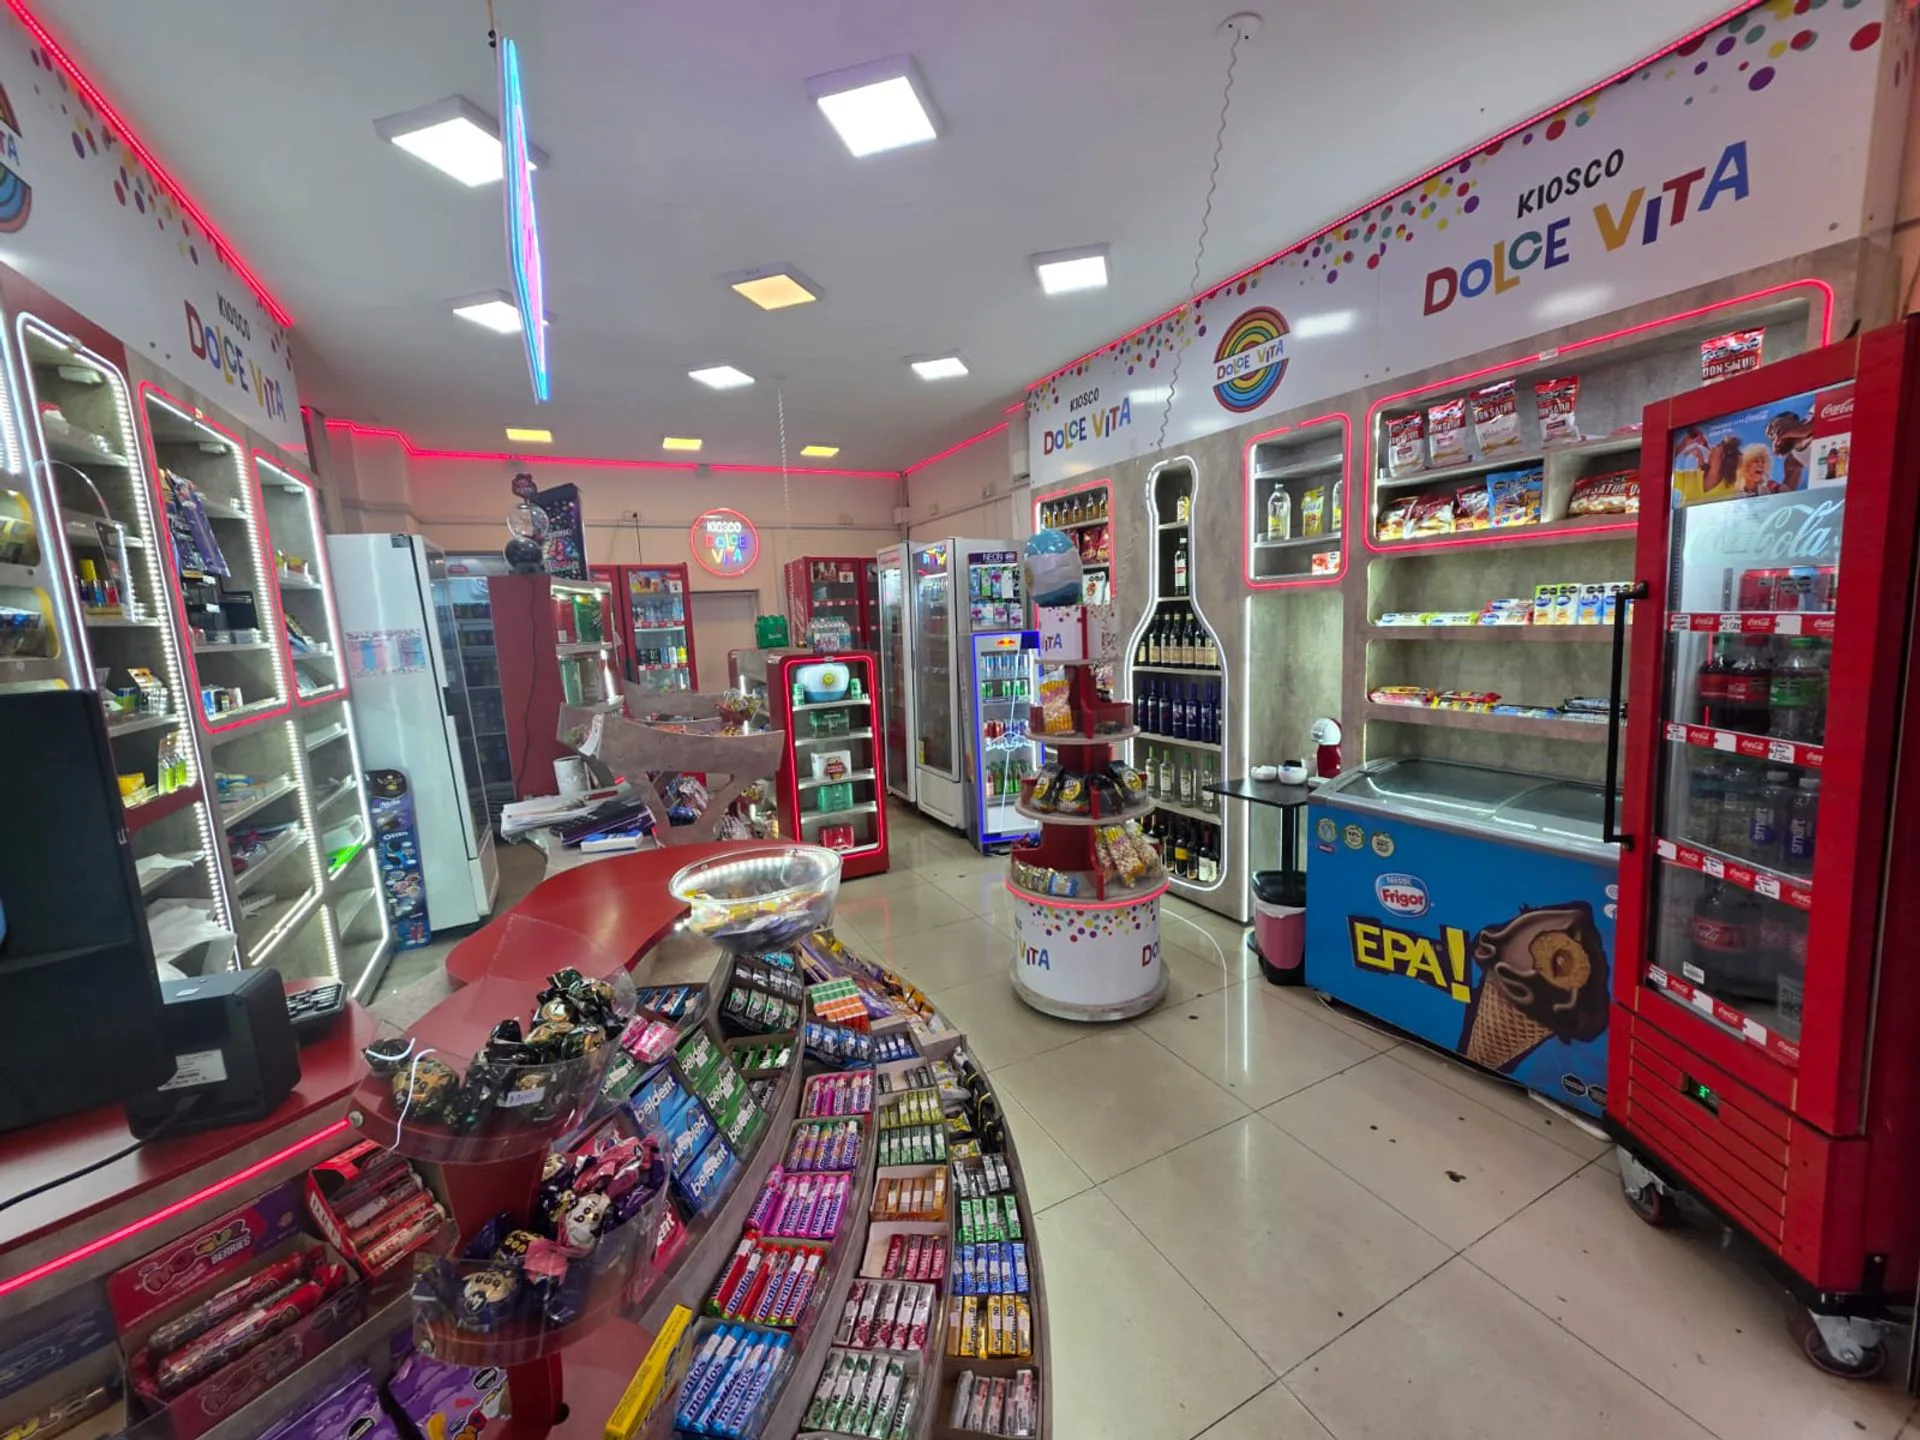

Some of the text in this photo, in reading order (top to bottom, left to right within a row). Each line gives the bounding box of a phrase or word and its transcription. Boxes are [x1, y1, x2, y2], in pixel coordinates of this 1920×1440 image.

[1517, 149, 1624, 218] KIOSCO
[1424, 141, 1749, 316] DOLCE VITA
[216, 291, 251, 341] KIOSCO
[184, 299, 287, 423] DOLCE VITA
[1217, 340, 1285, 380] DOLCE VITA
[1070, 387, 1100, 413] KIOSCO
[1044, 397, 1131, 455] DOLCE VITA
[705, 532, 748, 553] DOLCE
[706, 520, 742, 533] KIOSCO
[711, 547, 743, 567] VITA
[1382, 888, 1425, 907] Frigor
[1353, 920, 1472, 1004] EPA!
[634, 1075, 676, 1123] beldent
[211, 1236, 251, 1265] BERRIES
[727, 1269, 756, 1313] mentos
[759, 1272, 783, 1319] mentos
[773, 1270, 798, 1316] mentos
[679, 1361, 707, 1405] entos
[686, 1361, 724, 1419] mentos
[705, 1370, 741, 1427] mentos
[717, 1366, 755, 1422] mentos
[731, 1370, 767, 1427] mentos
